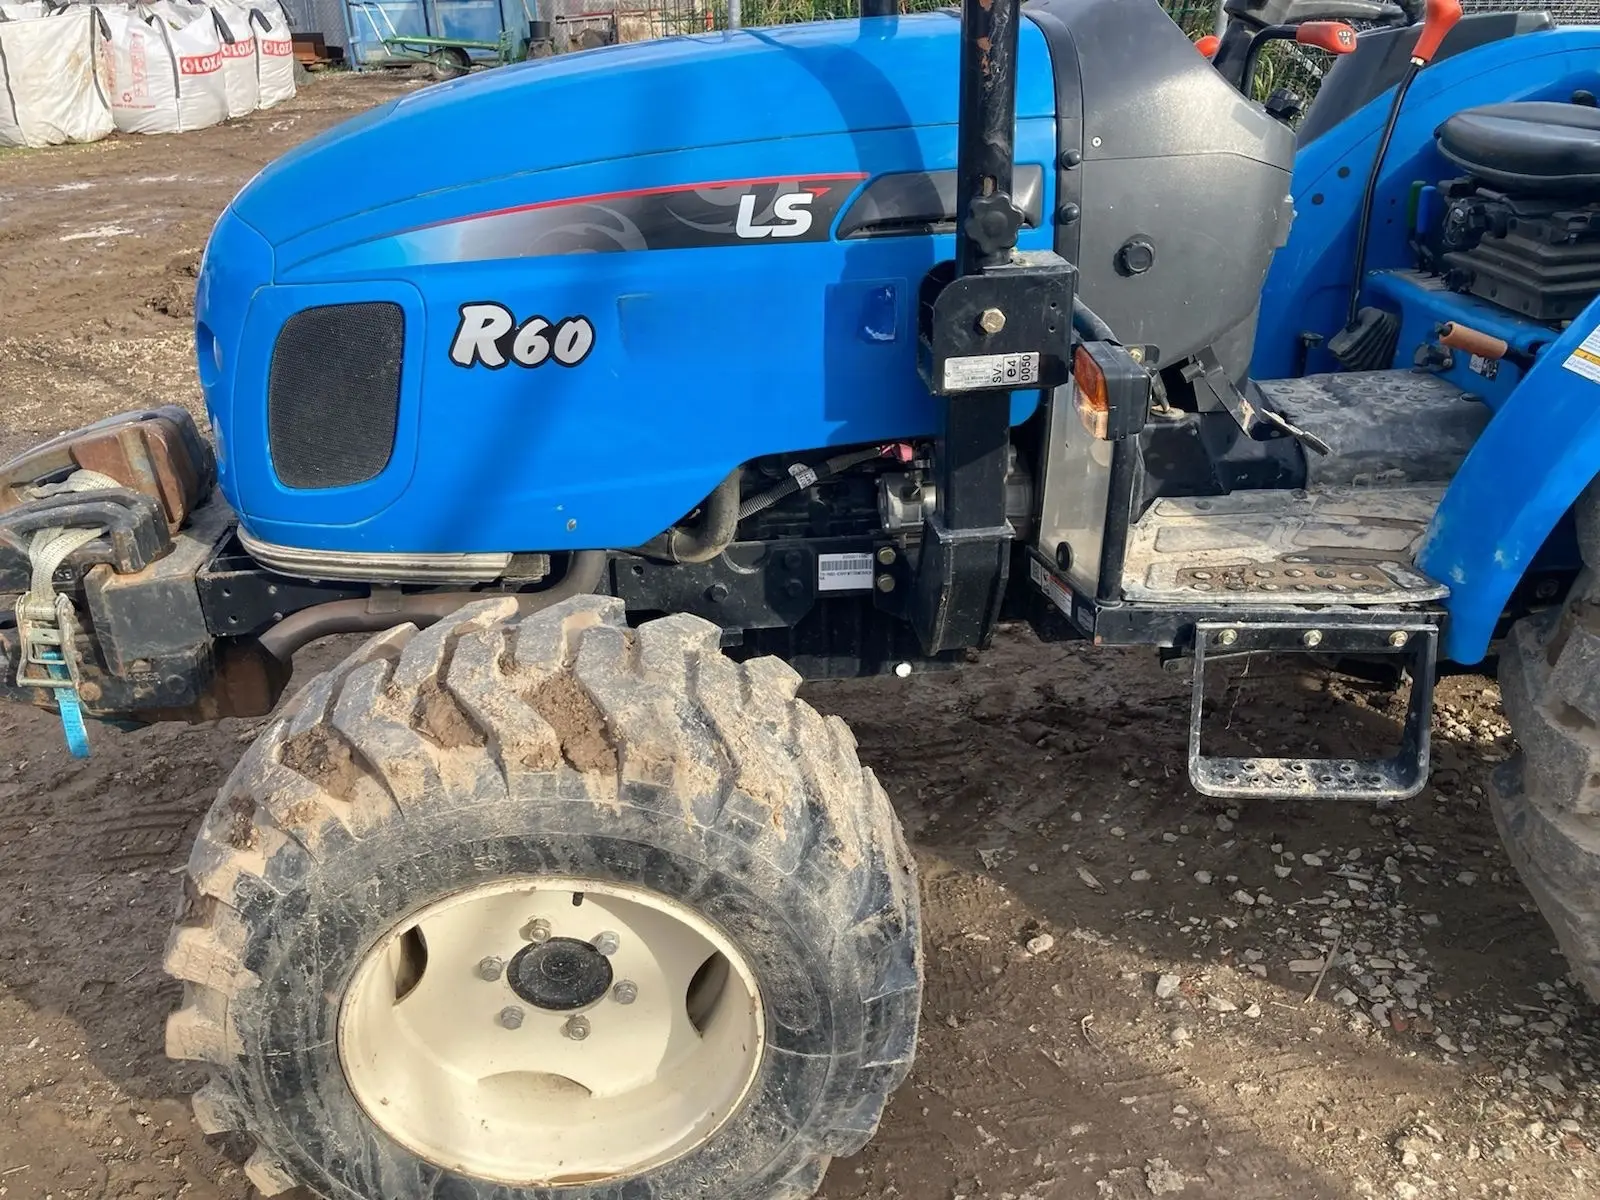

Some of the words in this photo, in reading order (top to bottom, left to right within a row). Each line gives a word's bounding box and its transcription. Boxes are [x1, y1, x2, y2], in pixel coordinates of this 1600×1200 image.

[735, 192, 814, 239] LS
[449, 301, 596, 370] R60
[1021, 355, 1032, 381] 0050
